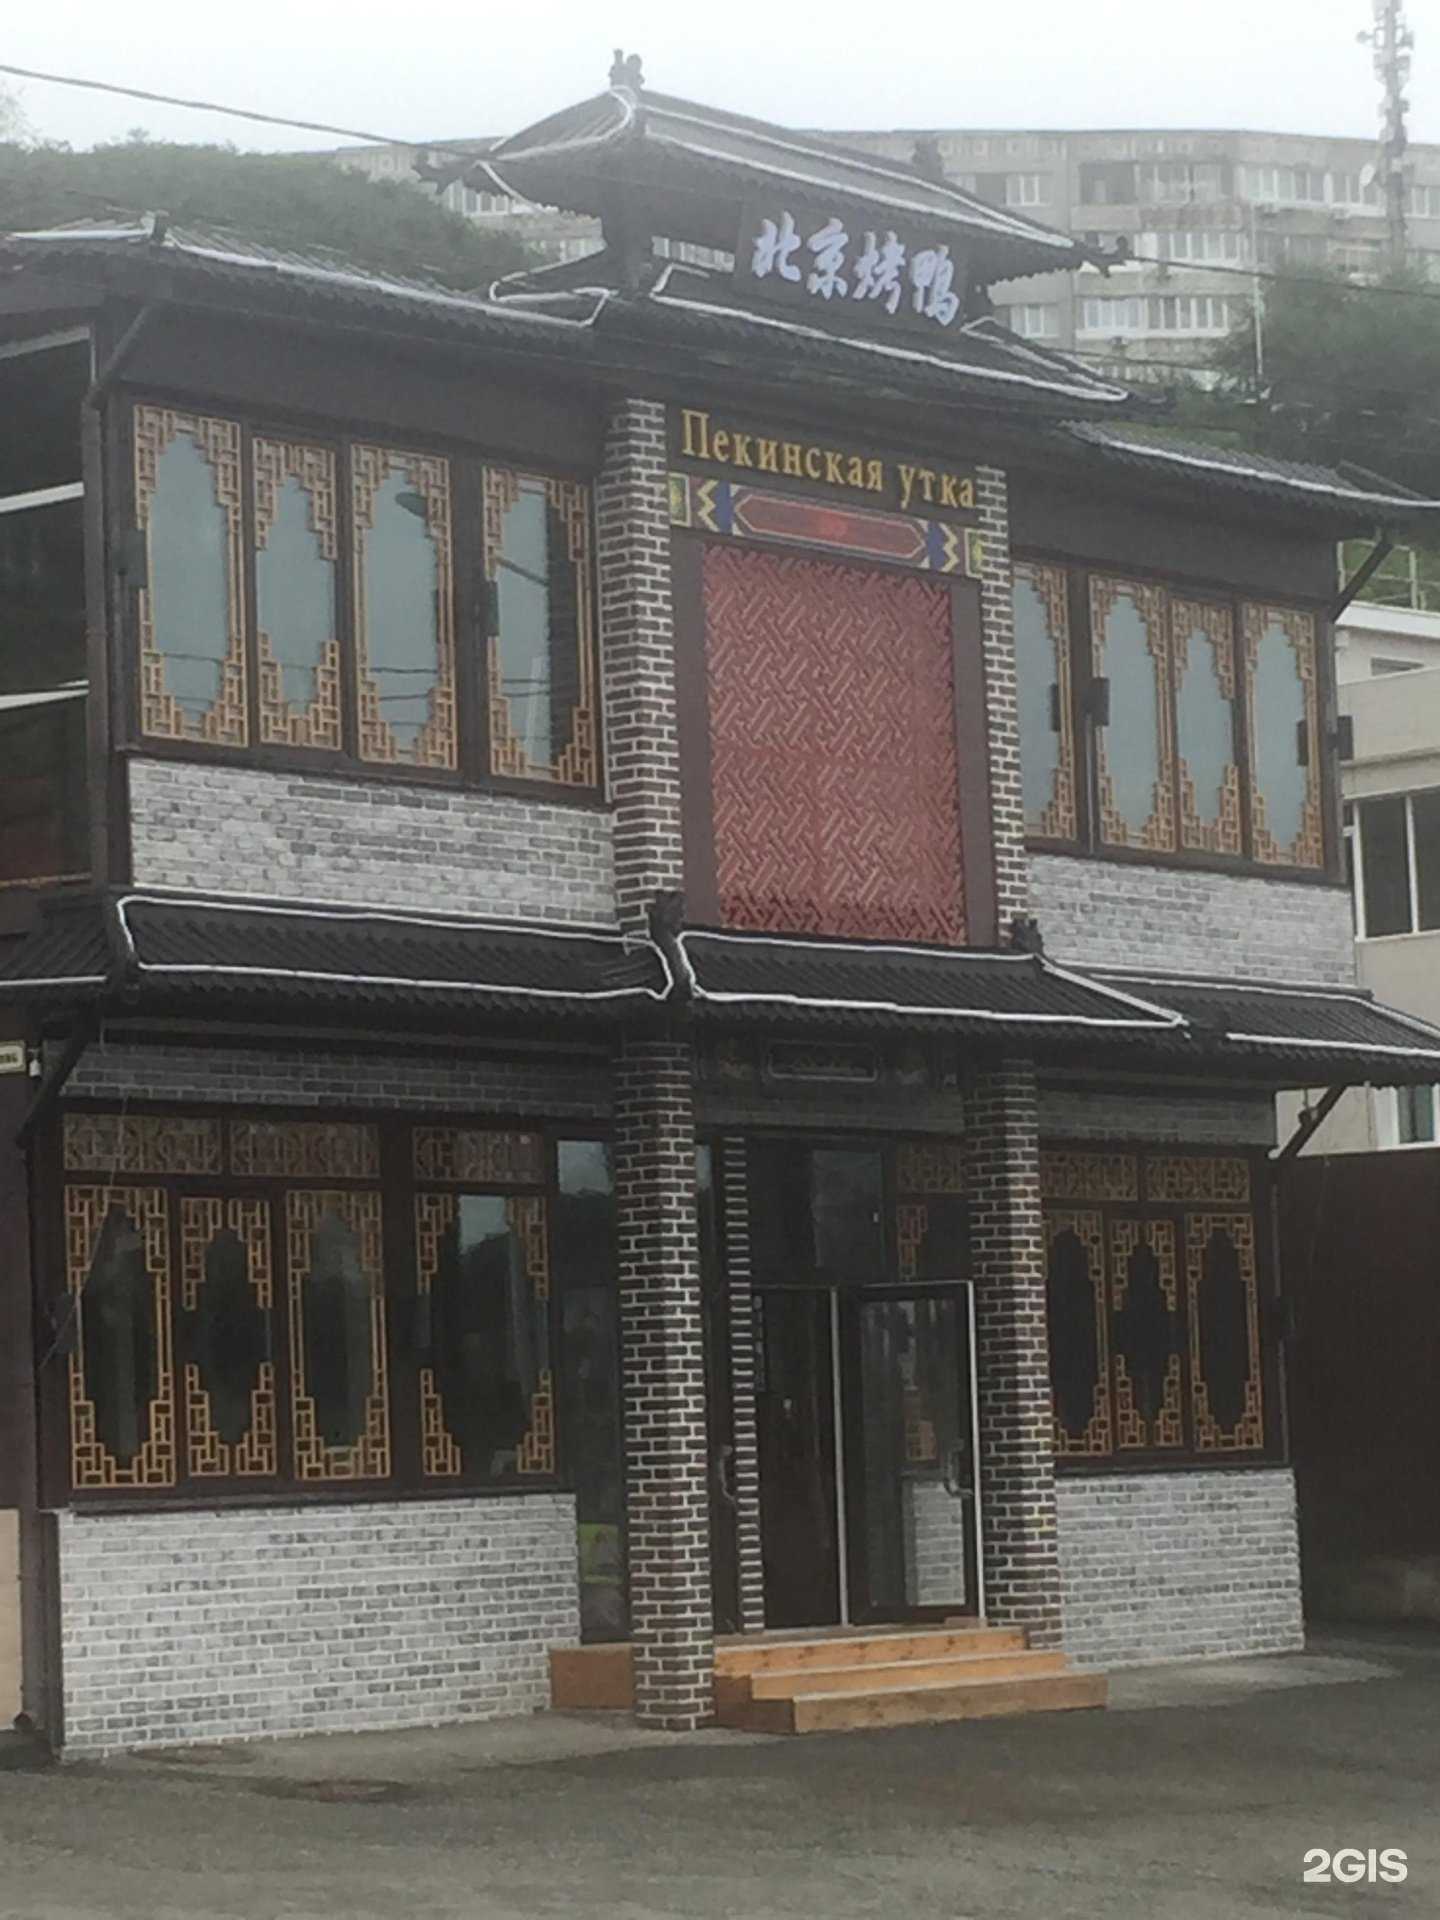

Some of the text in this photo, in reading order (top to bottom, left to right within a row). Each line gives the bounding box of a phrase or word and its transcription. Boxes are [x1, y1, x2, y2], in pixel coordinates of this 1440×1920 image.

[752, 211, 960, 326] 北京烤鸭
[681, 409, 976, 509] Пекинская утка
